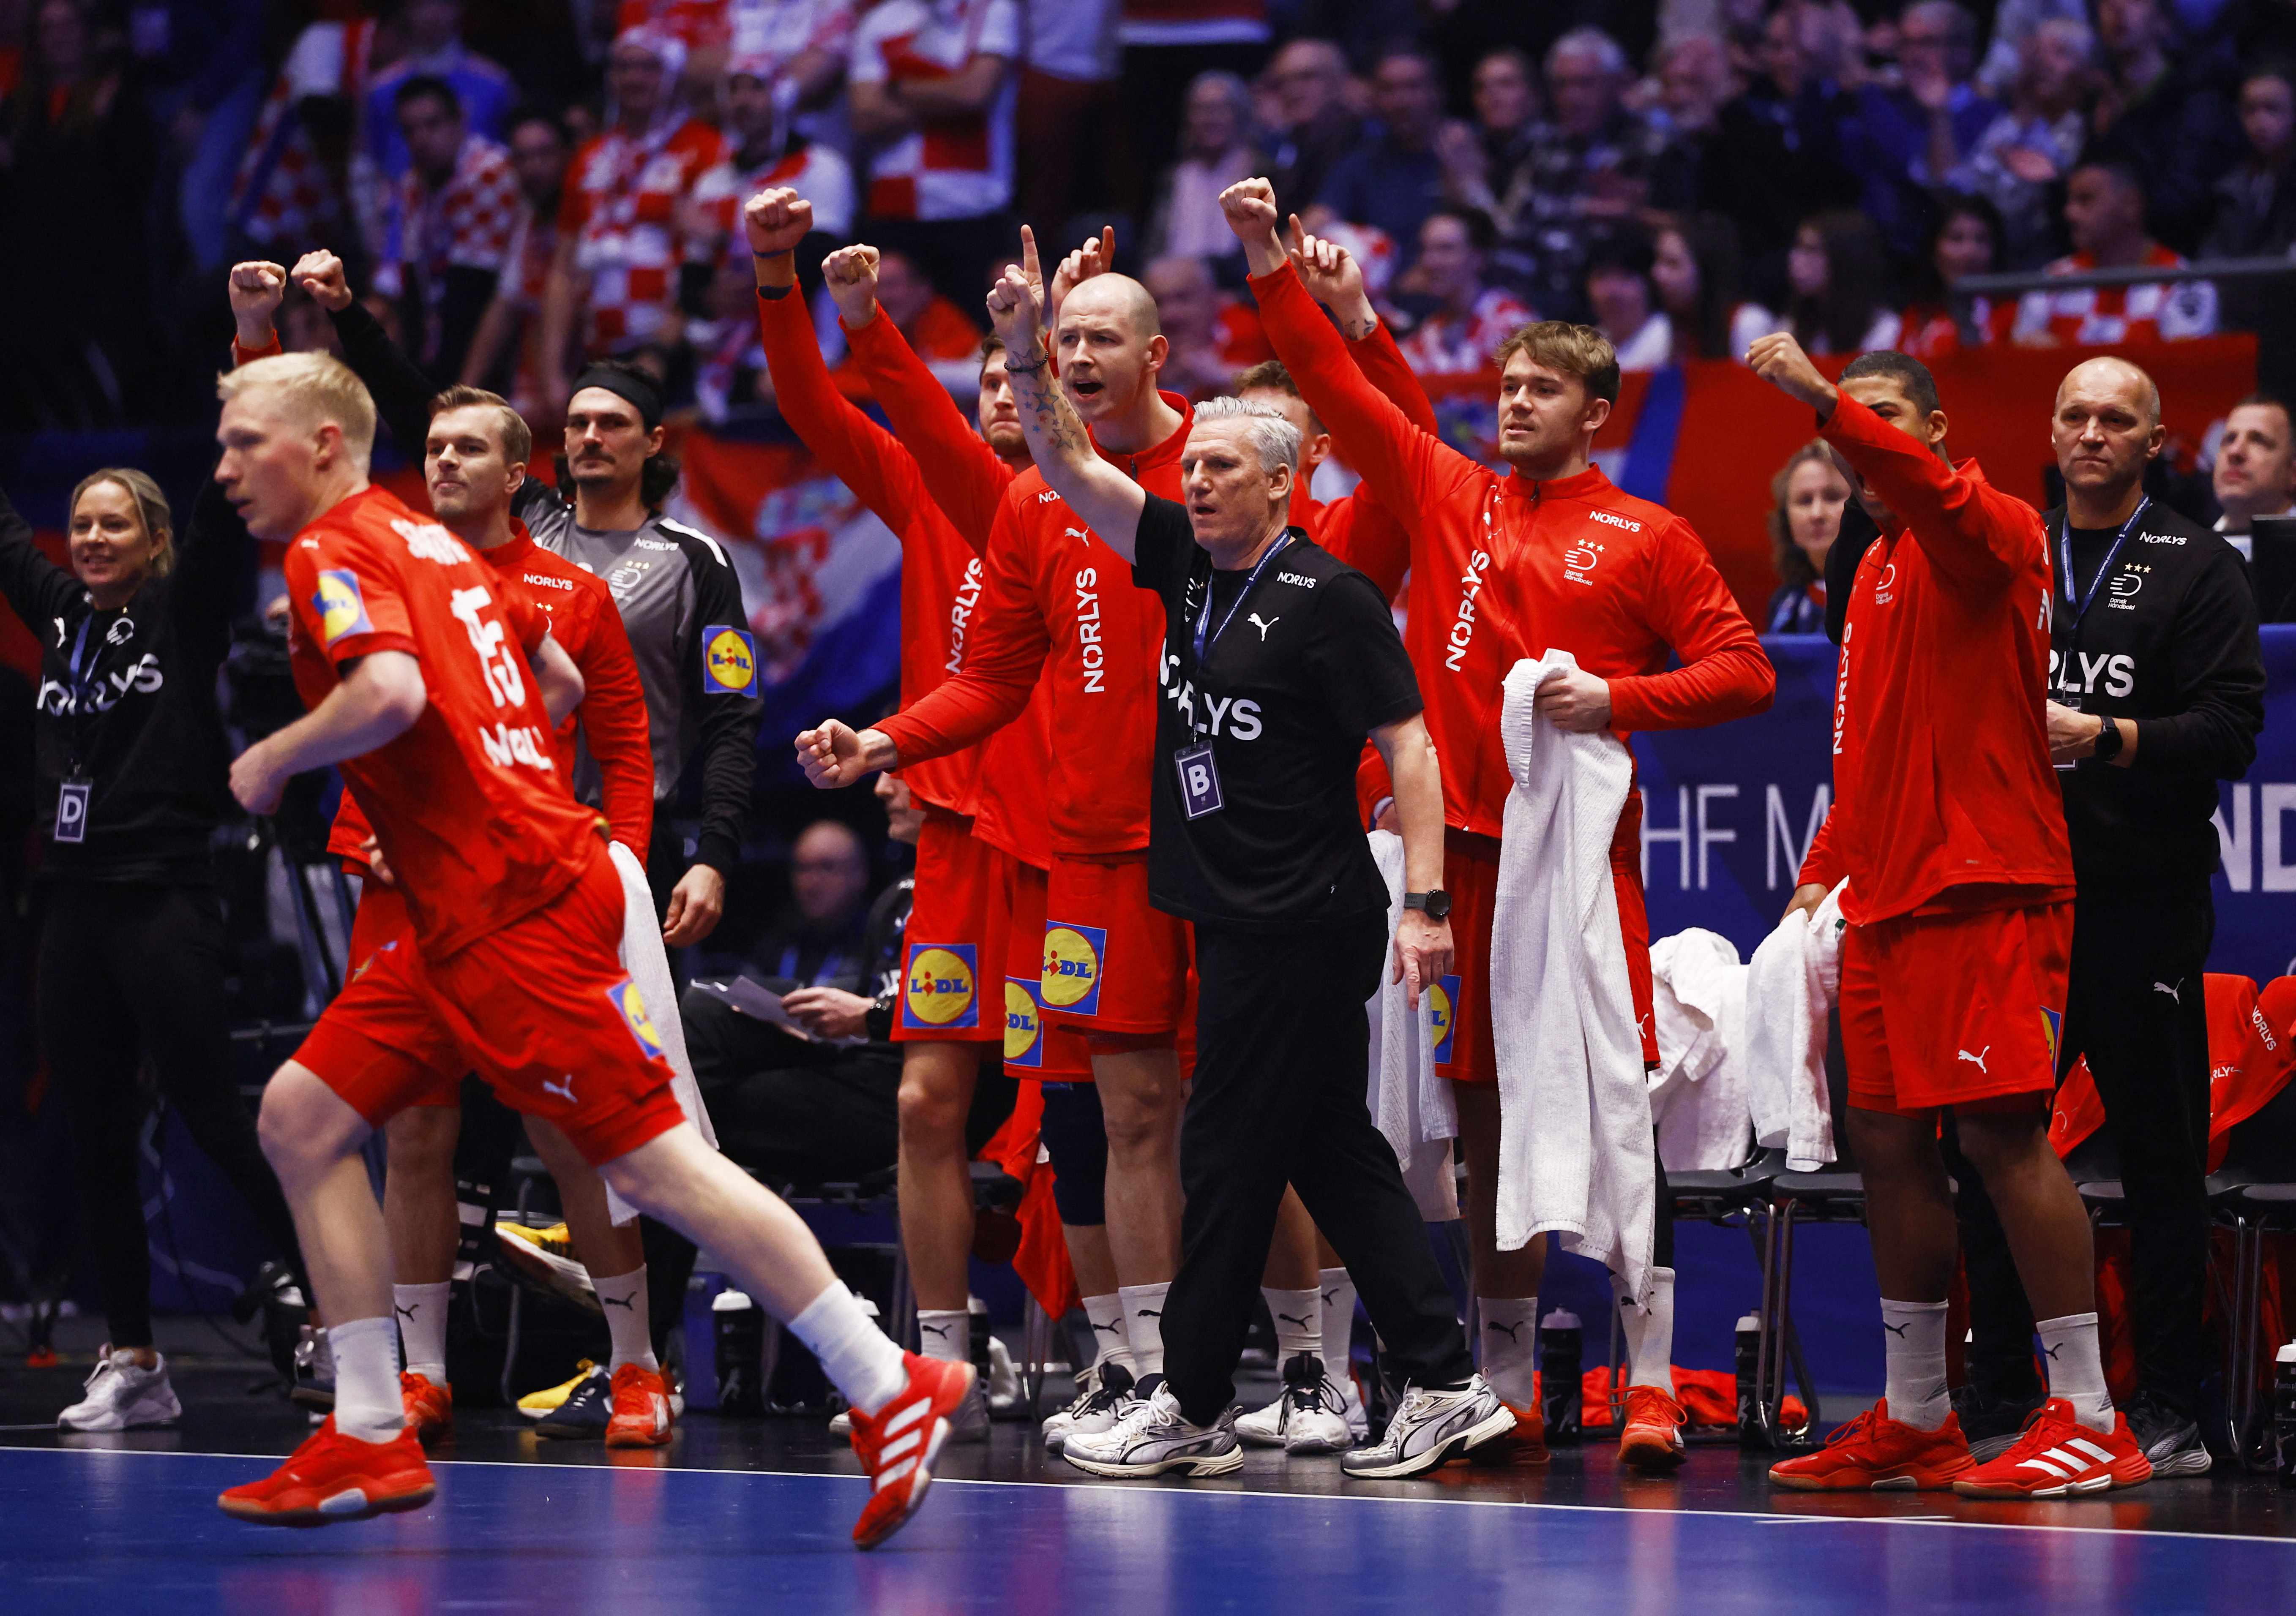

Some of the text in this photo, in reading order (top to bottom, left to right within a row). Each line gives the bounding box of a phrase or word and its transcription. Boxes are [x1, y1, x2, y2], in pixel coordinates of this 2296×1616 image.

[1039, 490, 1060, 504] NO
[1589, 511, 1641, 532] NORLYS
[633, 537, 679, 551] NORLYS
[2139, 531, 2187, 545] NORLYS
[1252, 559, 1266, 578] Federation
[1565, 569, 1583, 578] Dansk
[523, 573, 573, 591] NORLYS
[1277, 571, 1316, 589] NORLYS
[1563, 574, 1593, 586] Håndbold
[2089, 575, 2101, 595] Federation
[945, 558, 983, 673] NORLYS
[1445, 549, 1490, 672] NORLYS
[1076, 567, 1104, 693] NORLYS
[1833, 622, 1852, 755] NORLYS
[1188, 764, 1210, 797] B
[61, 795, 82, 824] D
[1006, 1013, 1035, 1030] DL
